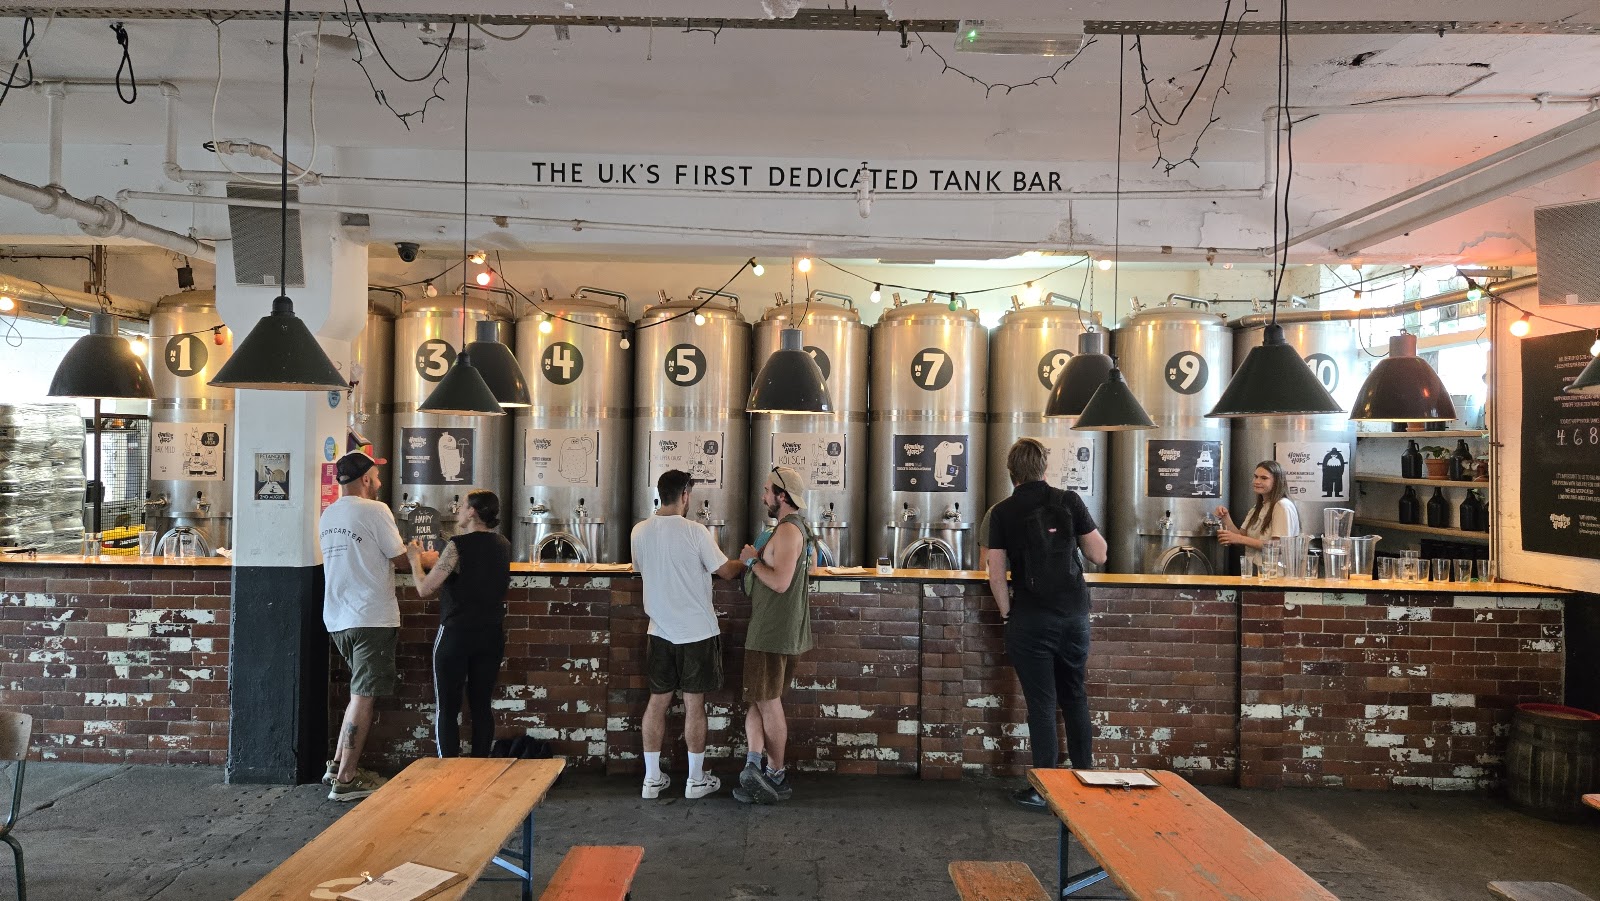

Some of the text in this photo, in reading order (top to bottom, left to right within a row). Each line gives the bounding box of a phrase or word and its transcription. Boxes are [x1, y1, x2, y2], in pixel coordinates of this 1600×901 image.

[532, 162, 583, 182] THE
[598, 163, 660, 184] U.K'S
[675, 164, 752, 186] FIRST
[929, 170, 1003, 191] TANK
[1013, 171, 1062, 192] BAR
[176, 337, 193, 371] 1
[425, 343, 449, 377] 3
[552, 345, 574, 379] 4
[675, 348, 697, 382] 5
[922, 352, 945, 386] 7
[1178, 354, 1200, 390] 9
[1556, 426, 1598, 445] 4 6 8
[414, 514, 434, 524] HAPPY
[416, 525, 431, 534] HOUR
